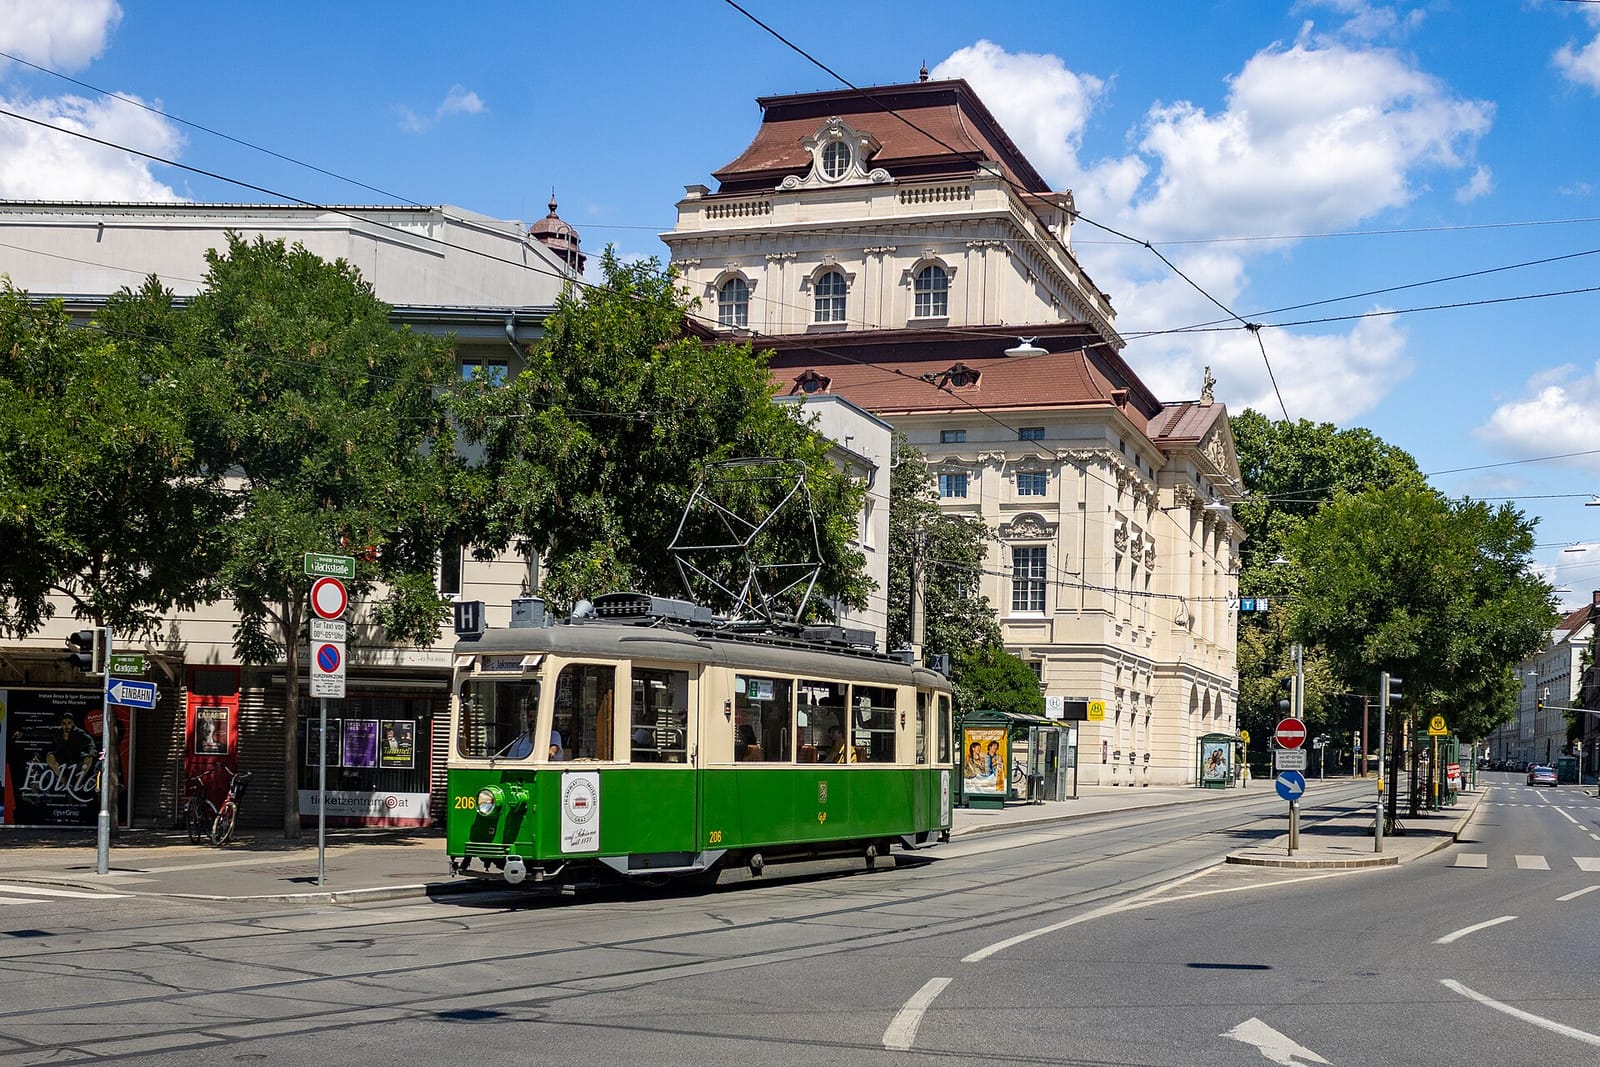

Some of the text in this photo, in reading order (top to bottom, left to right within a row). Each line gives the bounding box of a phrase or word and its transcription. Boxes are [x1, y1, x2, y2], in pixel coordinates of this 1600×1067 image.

[461, 604, 473, 629] H
[121, 687, 151, 701] EINBAHN
[565, 781, 597, 806] TRAMWAY MUSEUM
[310, 795, 384, 807] tiketzentrum
[455, 796, 475, 809] 206
[709, 831, 722, 843] 206
